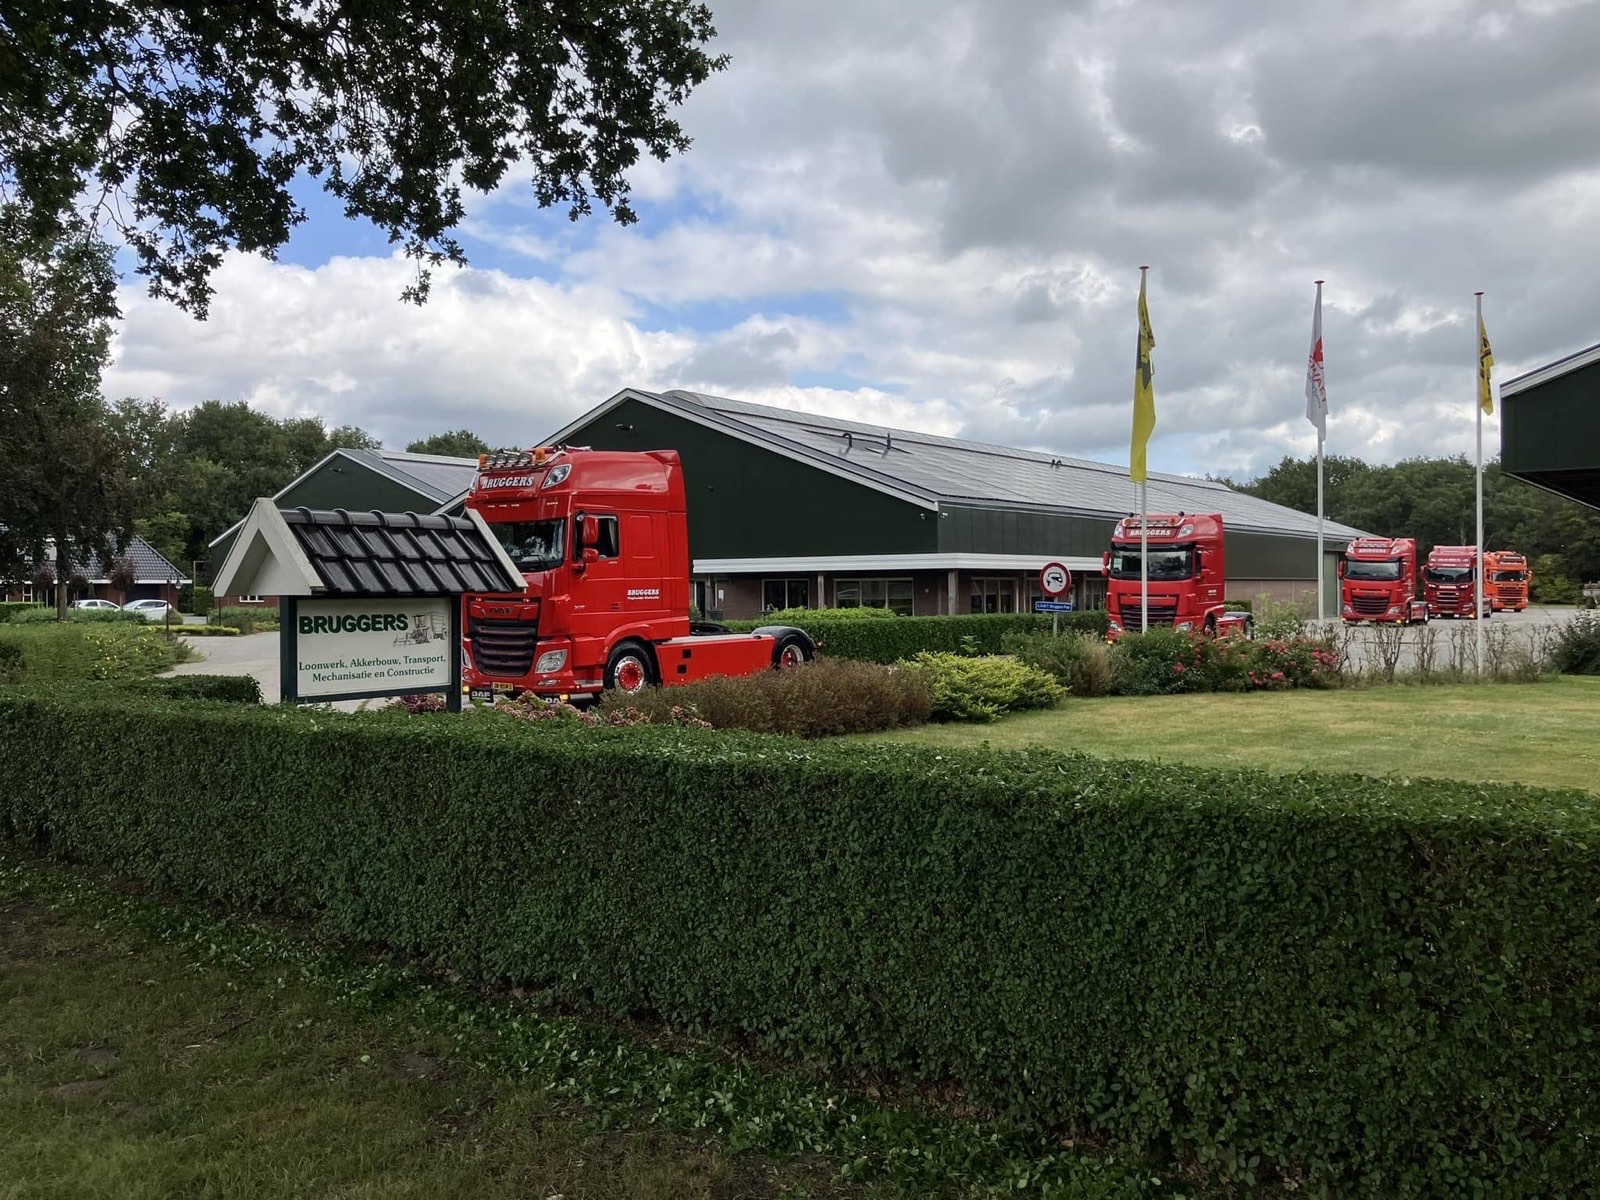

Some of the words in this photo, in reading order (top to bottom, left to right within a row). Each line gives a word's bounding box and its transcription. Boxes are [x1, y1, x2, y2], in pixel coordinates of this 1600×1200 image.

[482, 476, 535, 489] BRUGGERS
[627, 588, 660, 596] BRUGGERS
[299, 613, 409, 635] BRUGGERS
[299, 659, 348, 671] Loonwerk,
[350, 657, 402, 668] Akkerbouw,
[403, 654, 446, 665] Transport,
[312, 670, 372, 682] Mechanisatie
[386, 666, 435, 677] Constructie
[471, 690, 491, 698] DAF
